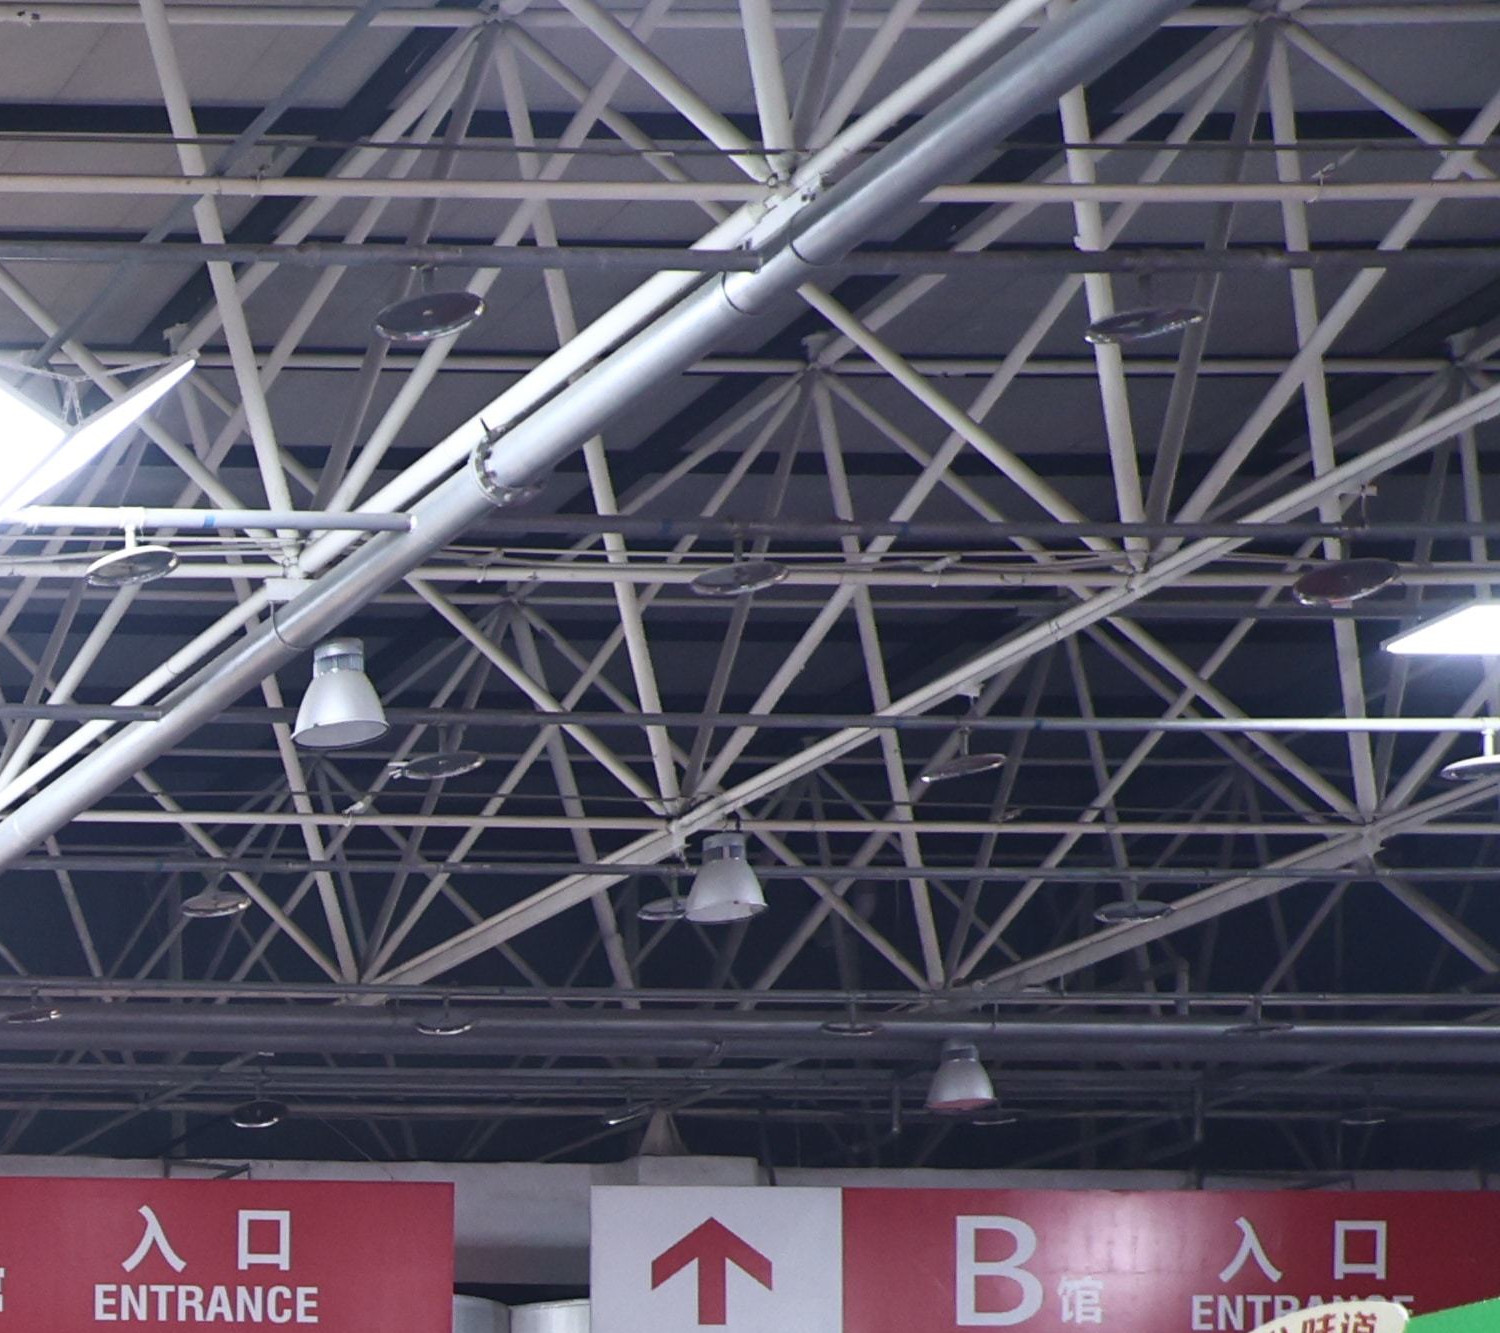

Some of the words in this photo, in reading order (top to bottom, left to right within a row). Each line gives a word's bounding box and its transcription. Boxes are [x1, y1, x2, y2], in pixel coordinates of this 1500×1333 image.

[122, 1203, 292, 1274] 入口
[1219, 1218, 1388, 1283] 入口
[94, 1283, 319, 1325] ENTRANCE
